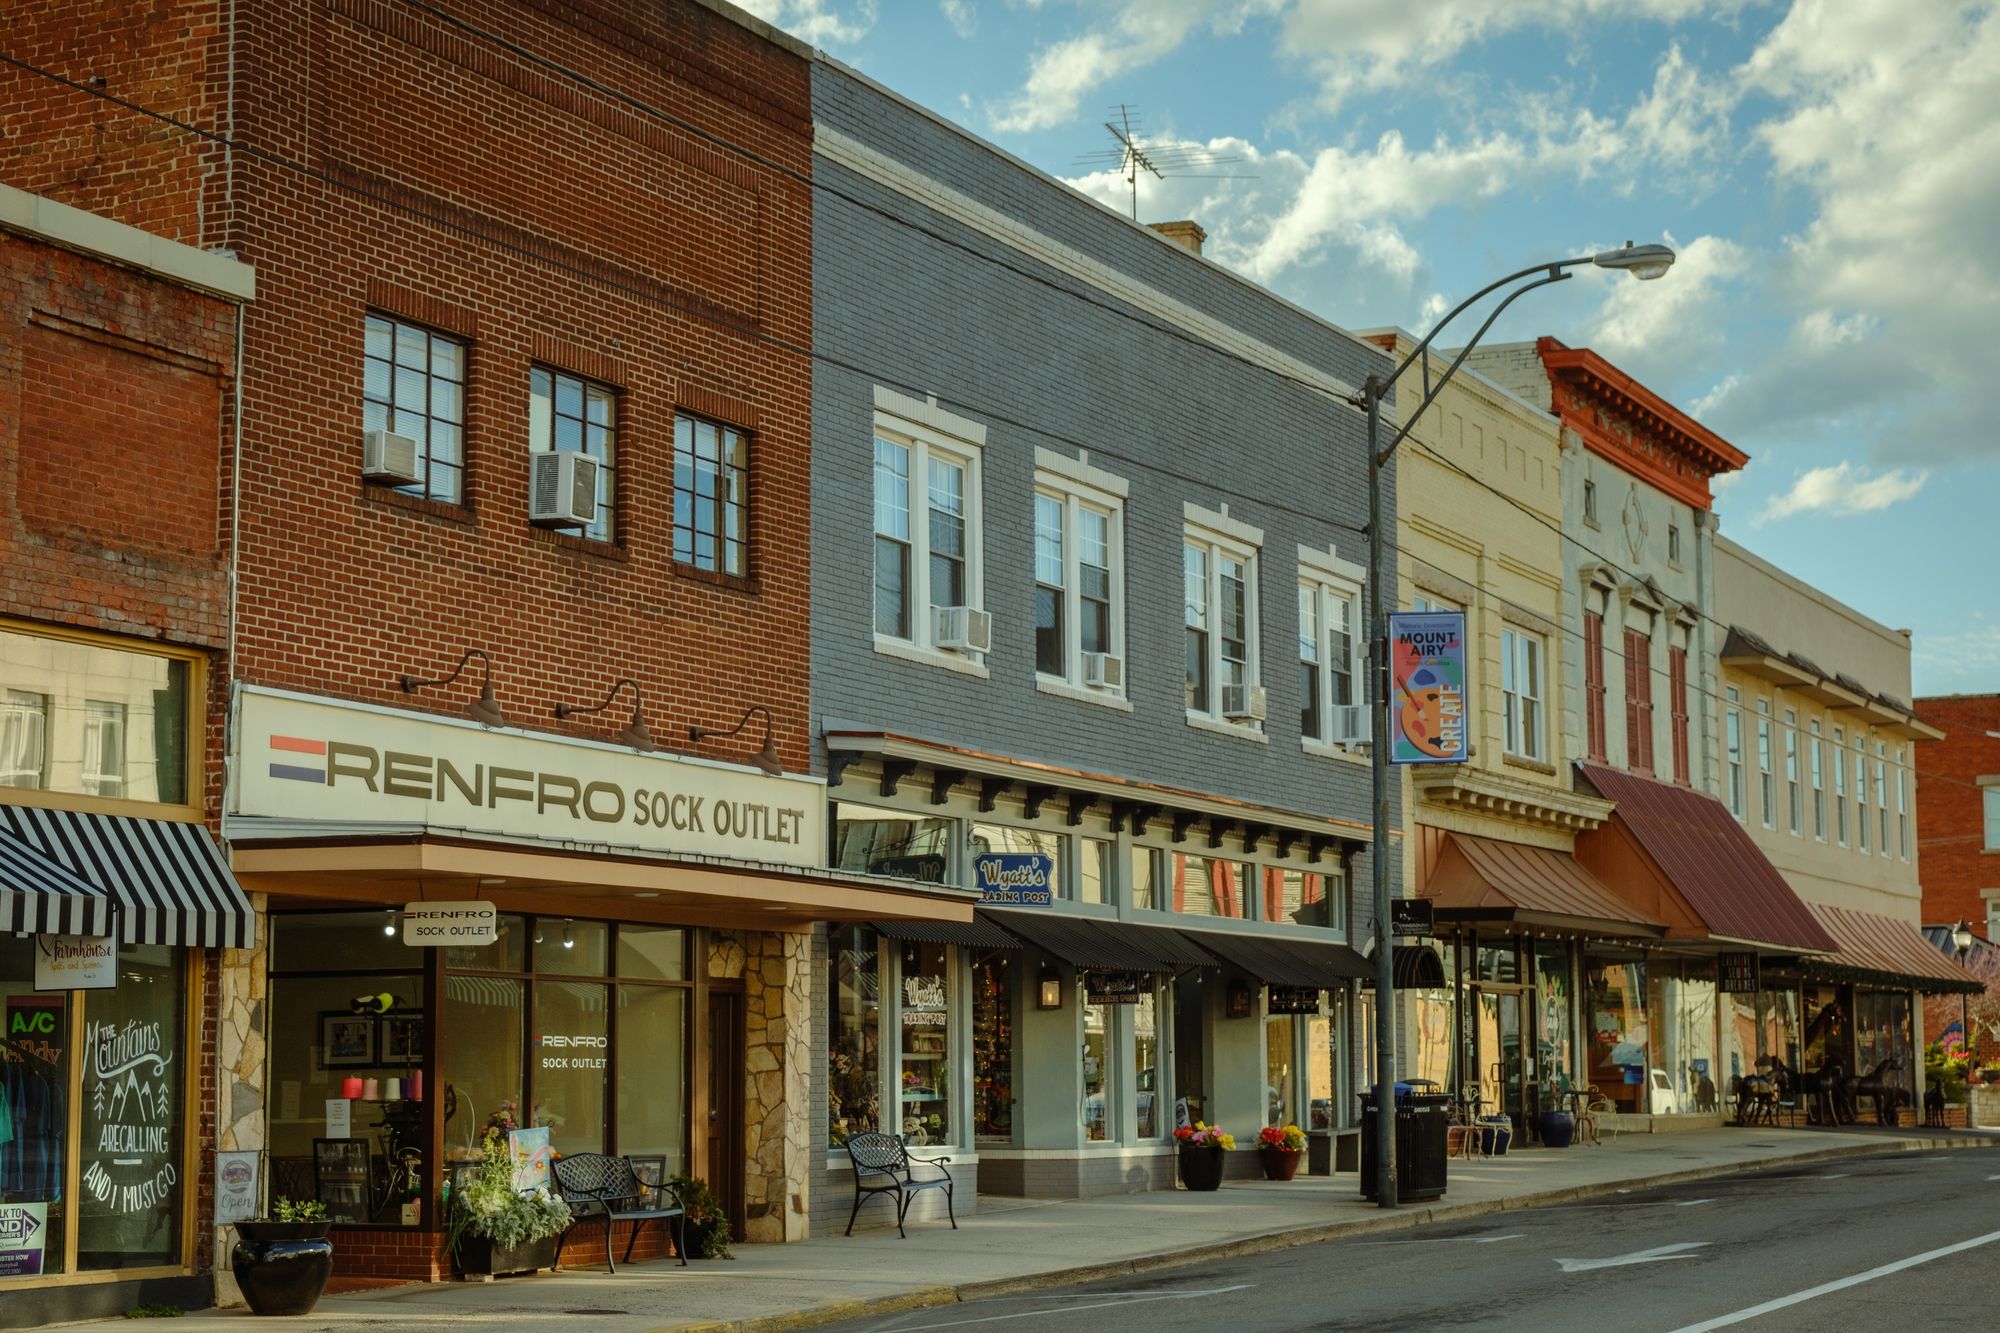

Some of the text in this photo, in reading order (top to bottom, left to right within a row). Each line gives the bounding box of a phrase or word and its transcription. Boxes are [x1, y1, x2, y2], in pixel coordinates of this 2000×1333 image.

[1400, 632, 1456, 644] MOUNT
[1410, 644, 1446, 656] AIRY
[1440, 684, 1462, 752] CREATE
[328, 741, 804, 845] RENFRO SOCK OUTLET
[980, 856, 1046, 890] Wyatt's
[979, 891, 1049, 903] RADING POST
[417, 911, 493, 919] RENFRO
[416, 926, 491, 936] SOCK OUTLET
[54, 939, 113, 961] Farmhouse
[905, 974, 944, 1011] Wyatt's
[11, 1012, 55, 1033] A/C
[903, 1012, 946, 1025] TRADING POST
[100, 1024, 117, 1040] THE
[542, 1035, 608, 1048] RENFRO
[82, 1019, 163, 1081] Mountains
[542, 1058, 607, 1068] SOCK OUTLET
[83, 1160, 176, 1213] AND I MUST GO
[221, 1193, 253, 1213] Open
[0, 1208, 21, 1218] LK TO
[0, 1220, 22, 1233] ND
